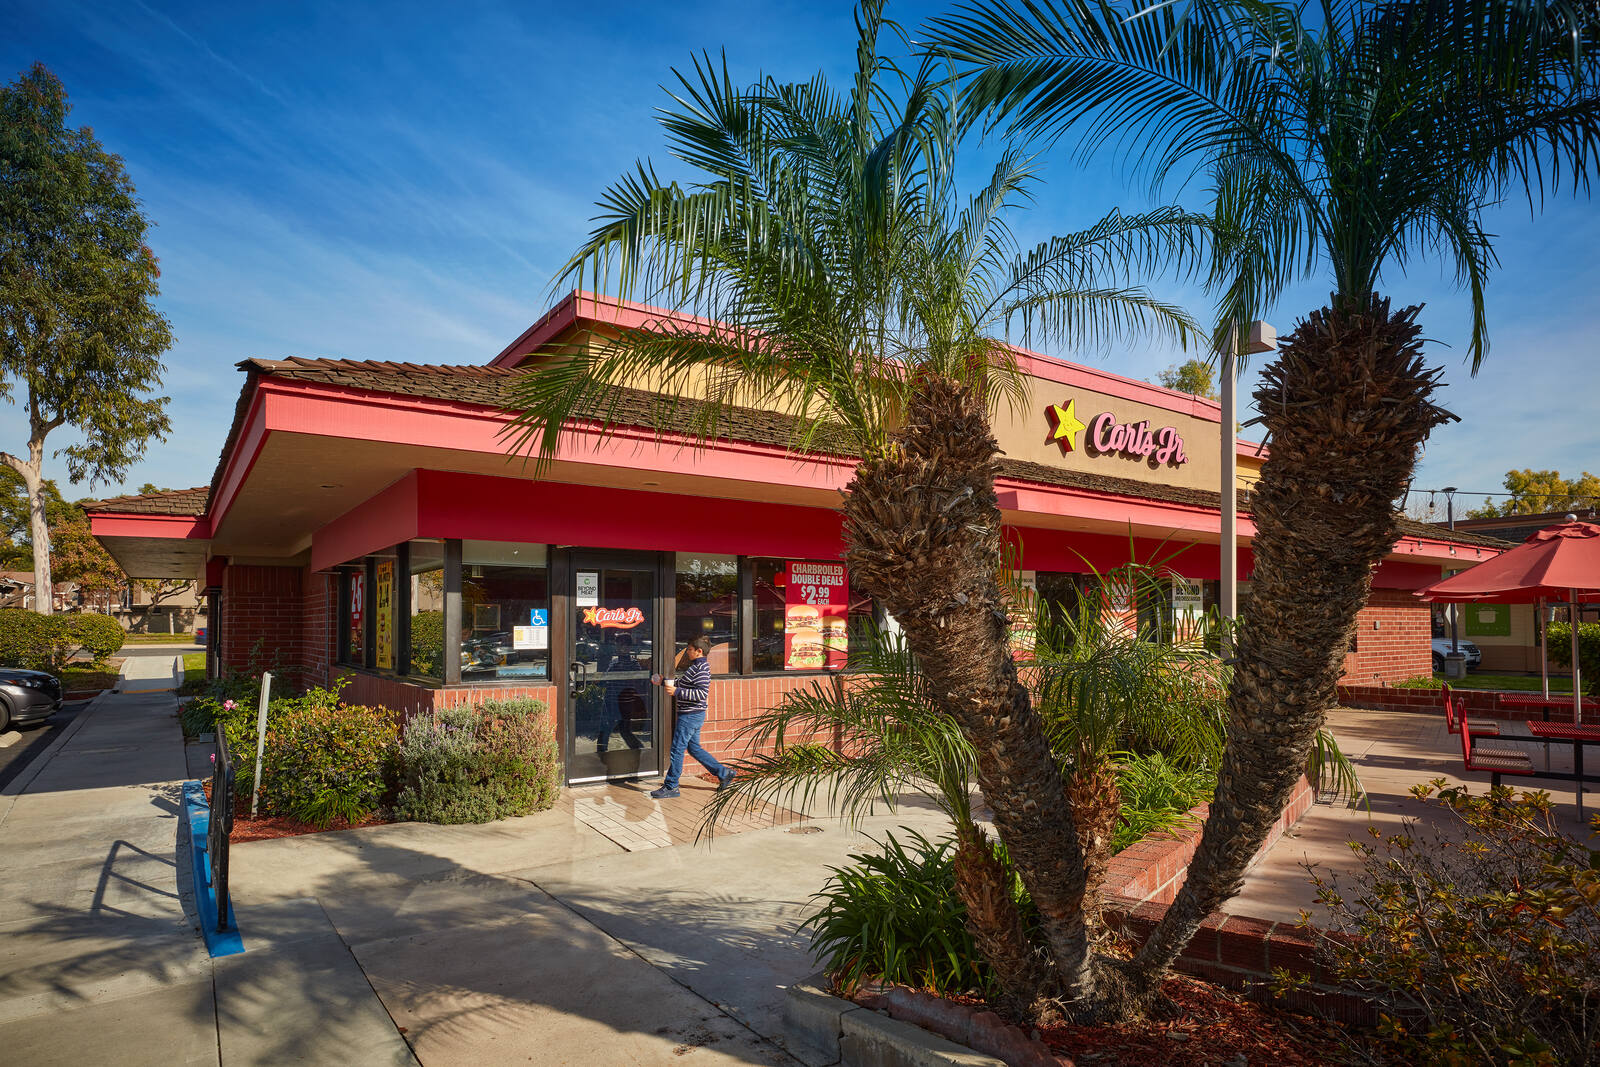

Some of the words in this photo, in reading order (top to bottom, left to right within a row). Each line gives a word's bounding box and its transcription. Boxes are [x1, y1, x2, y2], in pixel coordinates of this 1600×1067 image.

[1093, 411, 1156, 457] Carl's
[1155, 426, 1189, 464] Jr.
[791, 563, 844, 576] CHARBROILED
[791, 574, 820, 585] DOUBLE
[821, 575, 844, 586] DEALS
[801, 585, 830, 605] $2.99
[595, 609, 626, 622] Carl's
